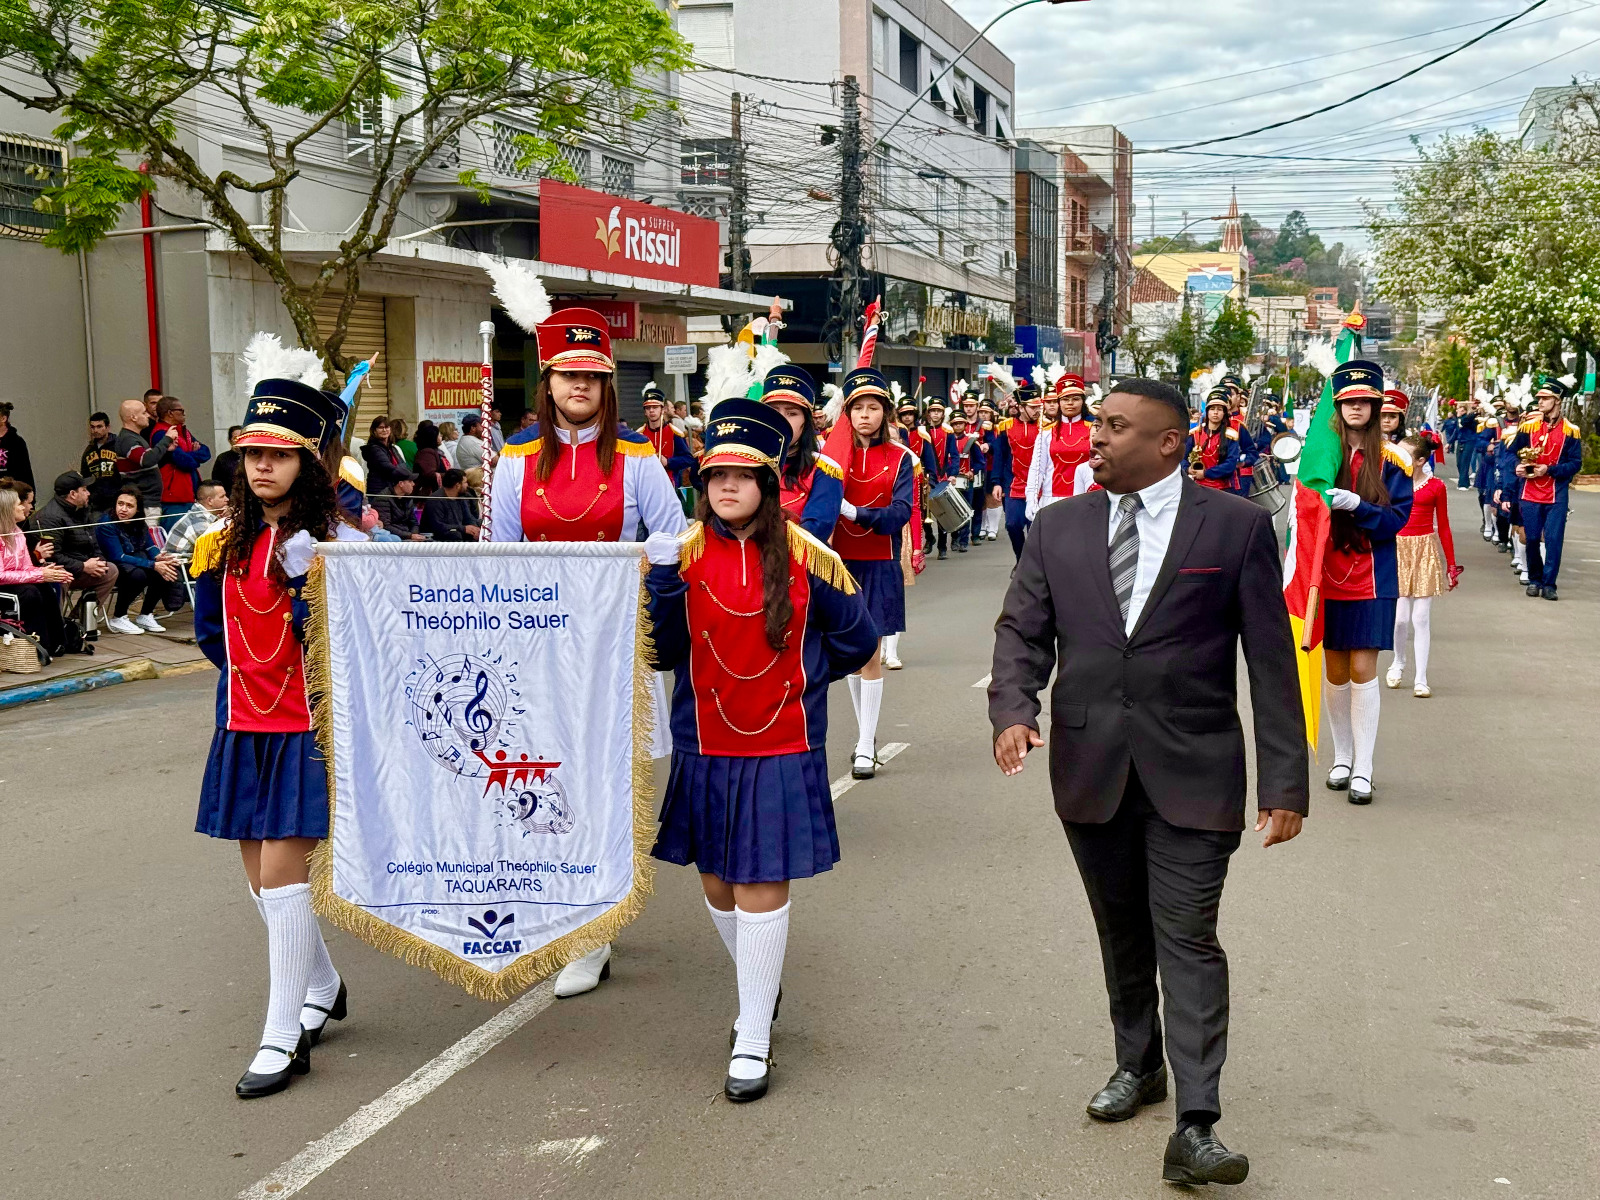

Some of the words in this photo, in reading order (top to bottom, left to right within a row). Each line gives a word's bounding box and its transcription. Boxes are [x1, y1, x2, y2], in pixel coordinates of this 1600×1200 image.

[649, 216, 675, 232] SUPPER
[625, 217, 680, 267] Rissul
[101, 461, 114, 472] 87
[409, 584, 474, 603] Banda
[481, 582, 559, 603] Musical
[401, 611, 501, 634] Theóphilo
[508, 611, 569, 630] Sauer
[387, 861, 433, 875] Colégio
[437, 861, 494, 876] Municipal
[500, 860, 557, 874] Theóphilo
[560, 863, 597, 874] Sauer
[445, 878, 543, 894] TAQUARA/RS
[463, 940, 521, 954] FACCAT
